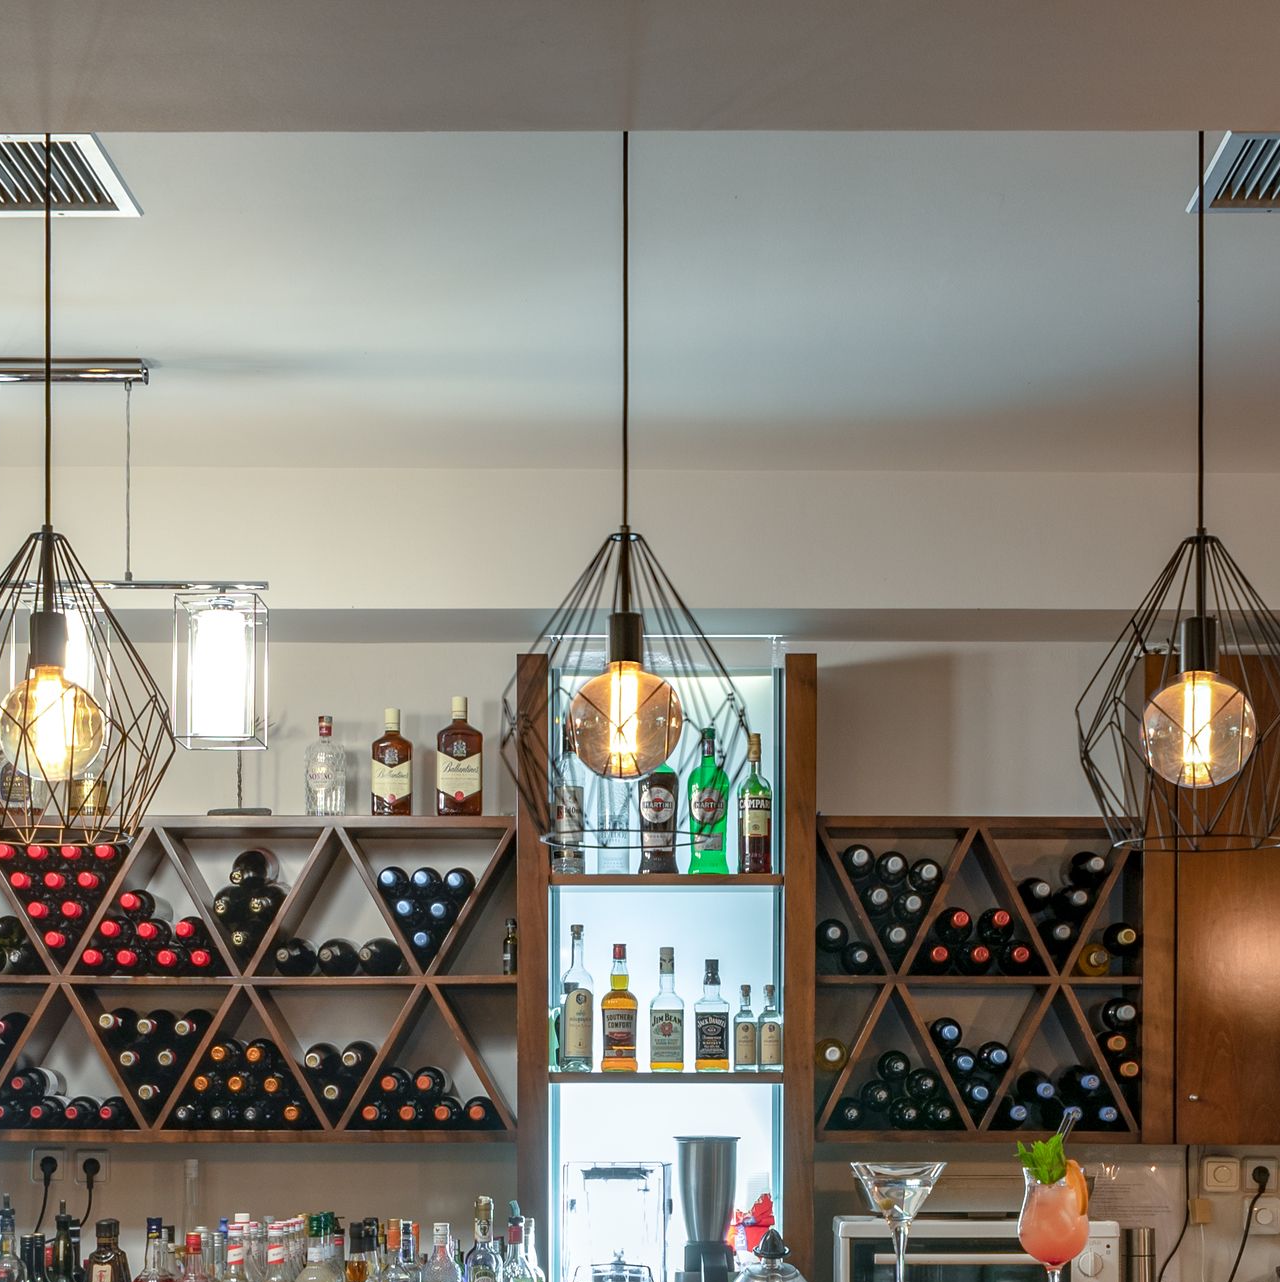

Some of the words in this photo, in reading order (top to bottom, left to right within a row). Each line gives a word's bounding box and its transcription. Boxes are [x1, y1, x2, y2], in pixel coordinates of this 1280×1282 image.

[645, 801, 673, 809] MARTINI
[739, 799, 771, 809] CAMPAR
[652, 1016, 664, 1027] JIM
[664, 1012, 682, 1027] BEAM
[697, 1018, 709, 1028] JACK
[607, 1021, 632, 1029] COMFORT
